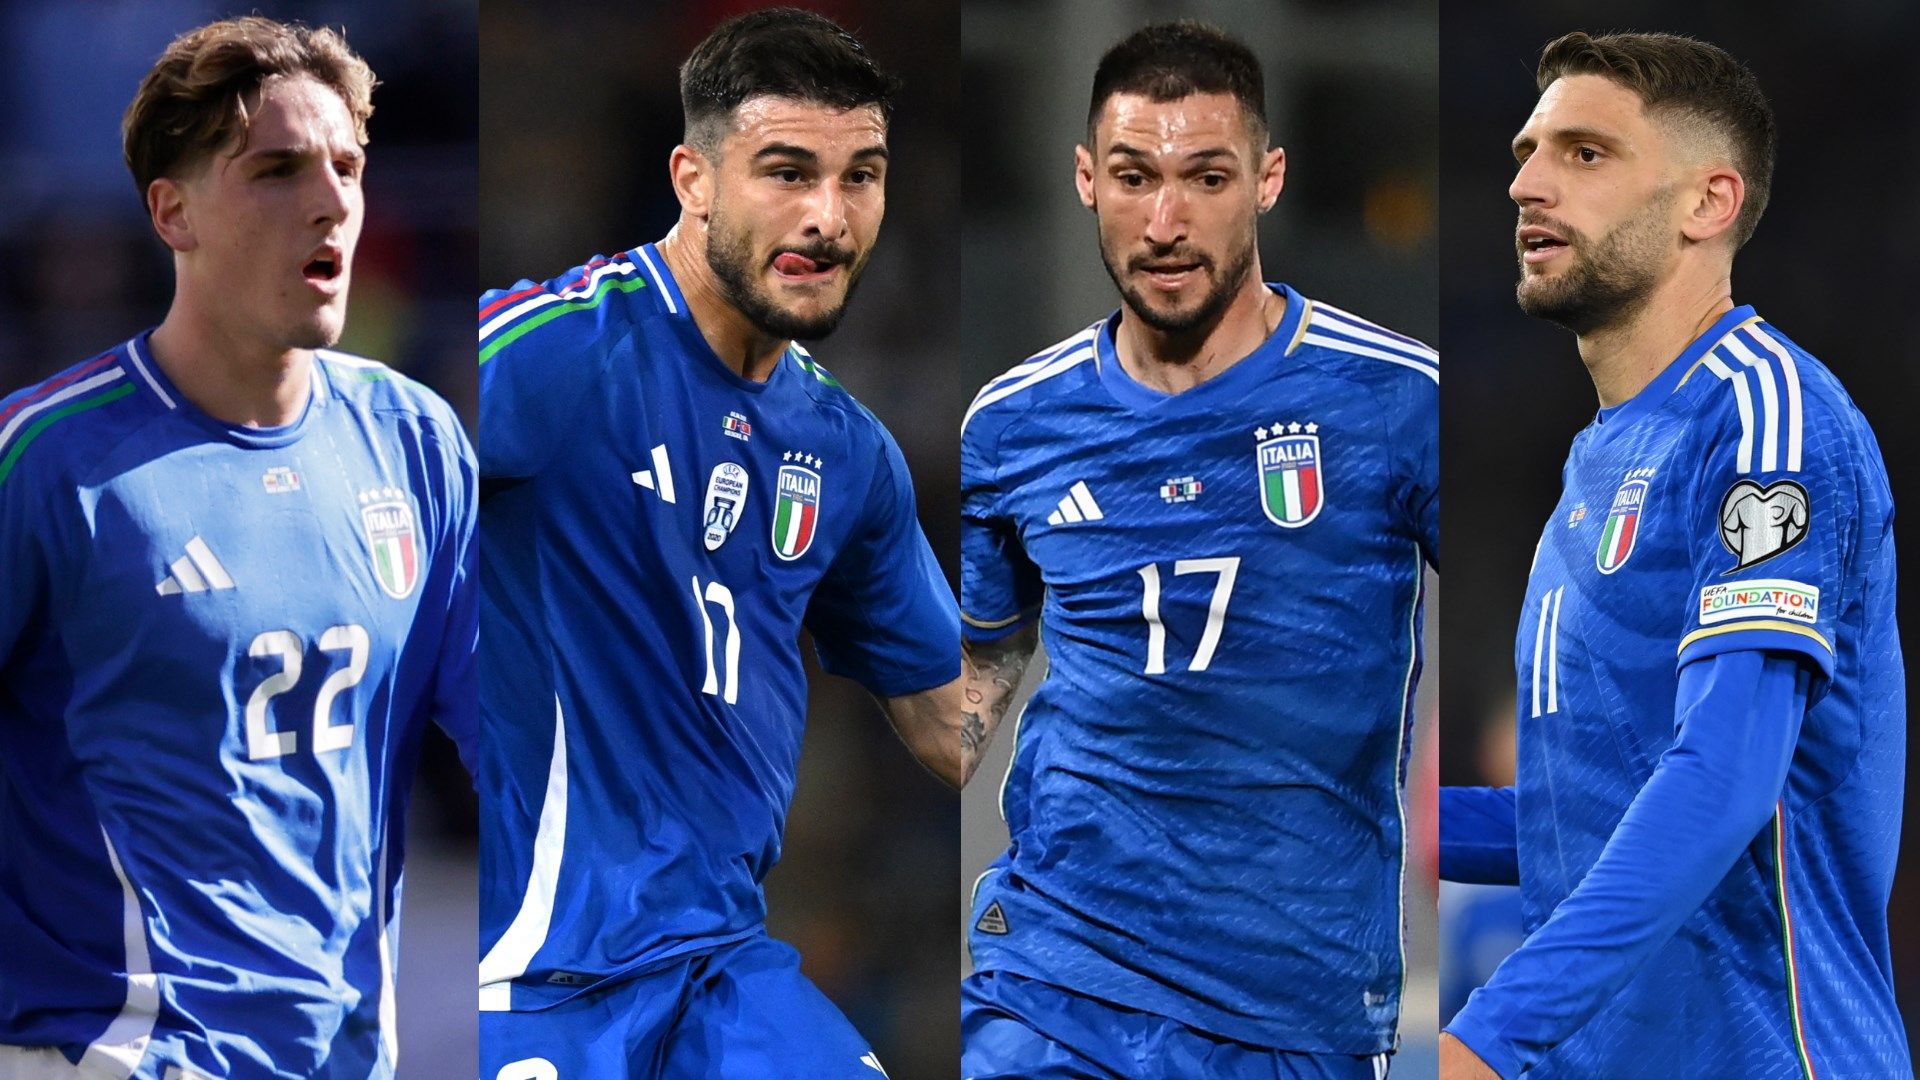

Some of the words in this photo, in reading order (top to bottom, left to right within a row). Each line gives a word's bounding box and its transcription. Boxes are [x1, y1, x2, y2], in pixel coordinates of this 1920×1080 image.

[1262, 442, 1314, 466] ITALIA
[714, 484, 741, 496] CHAMPIONS
[715, 476, 743, 489] EUROPEAN
[781, 473, 816, 497] ITALIA
[1615, 487, 1641, 507] ITALIA
[368, 510, 410, 531] ITALIA
[1704, 586, 1728, 597] UEFA
[1136, 556, 1241, 675] 17
[1775, 606, 1786, 615] for
[1788, 608, 1814, 620] children
[692, 575, 741, 705] 17
[1531, 585, 1565, 719] 11
[245, 623, 370, 760] 22
